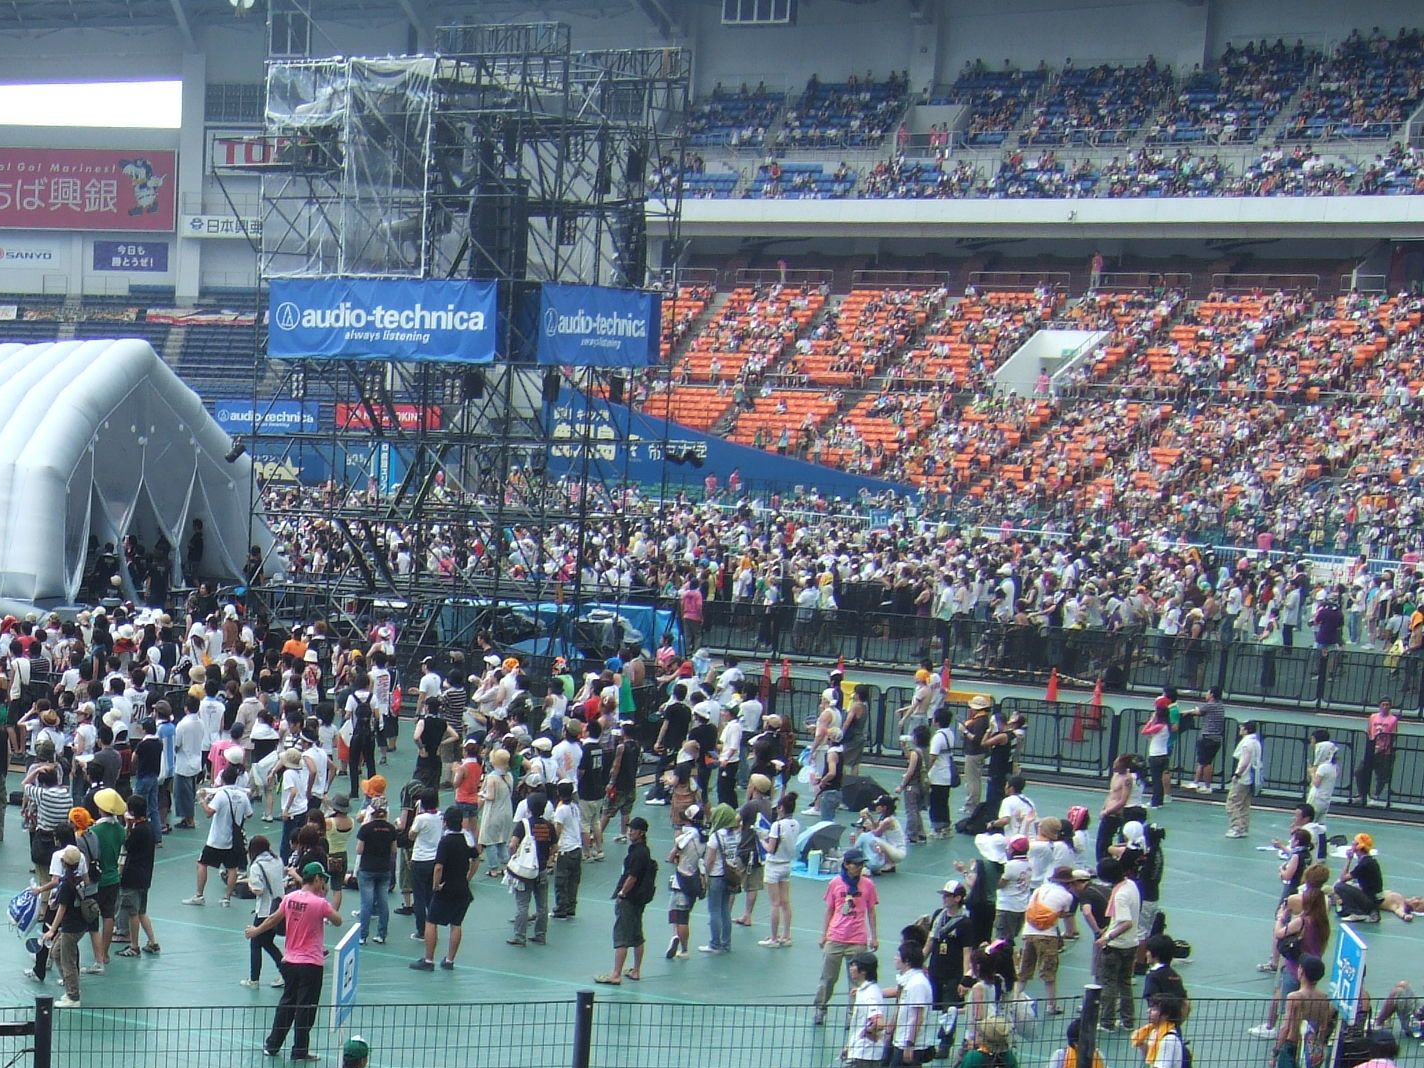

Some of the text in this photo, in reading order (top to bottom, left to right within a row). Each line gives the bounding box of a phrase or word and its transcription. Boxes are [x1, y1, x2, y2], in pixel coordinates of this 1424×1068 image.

[17, 163, 41, 173] Go!
[50, 163, 116, 174] Marines!
[6, 250, 52, 261] SANYO
[302, 302, 485, 331] audio-technica
[558, 309, 646, 338] audio-technica
[345, 329, 430, 344] always listening
[230, 412, 314, 424] audio-technica
[287, 901, 308, 912] STAFF
